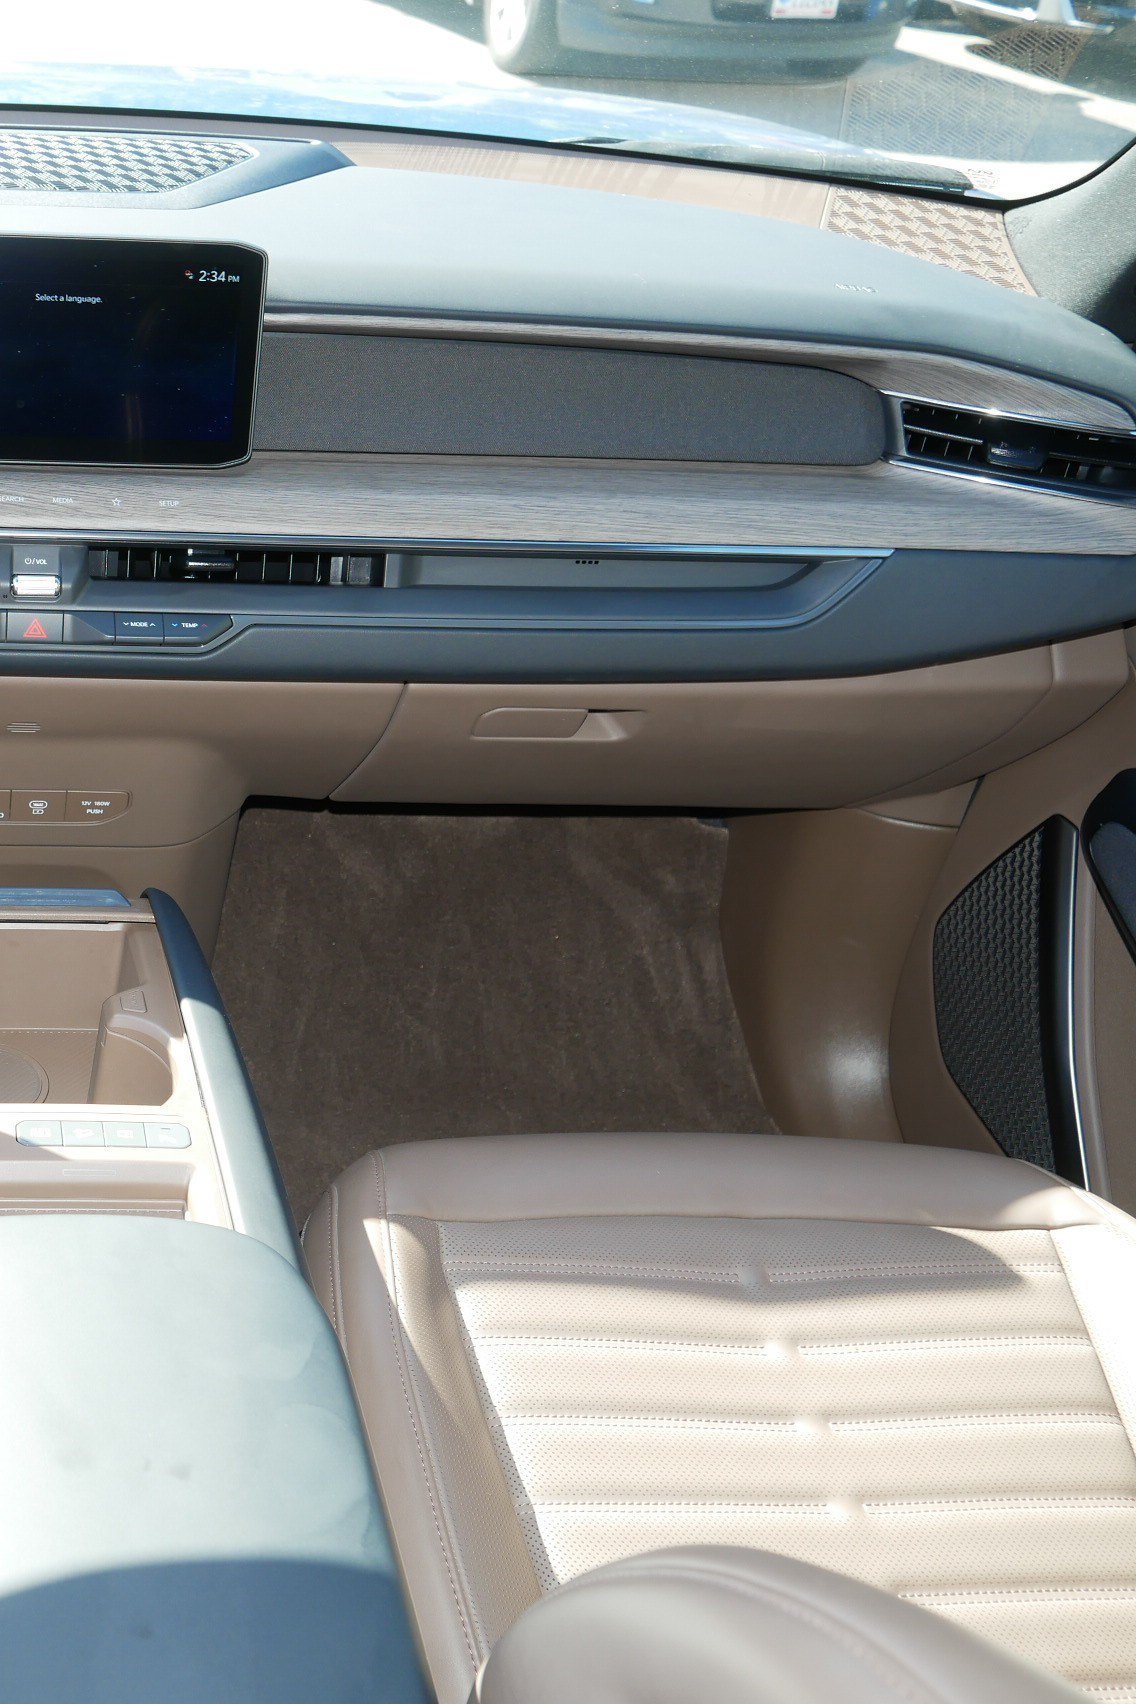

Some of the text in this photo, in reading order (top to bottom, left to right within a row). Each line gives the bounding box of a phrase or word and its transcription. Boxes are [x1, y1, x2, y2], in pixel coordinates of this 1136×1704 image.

[199, 270, 226, 282] 2:34
[35, 293, 58, 302] Select
[65, 294, 103, 305] language.
